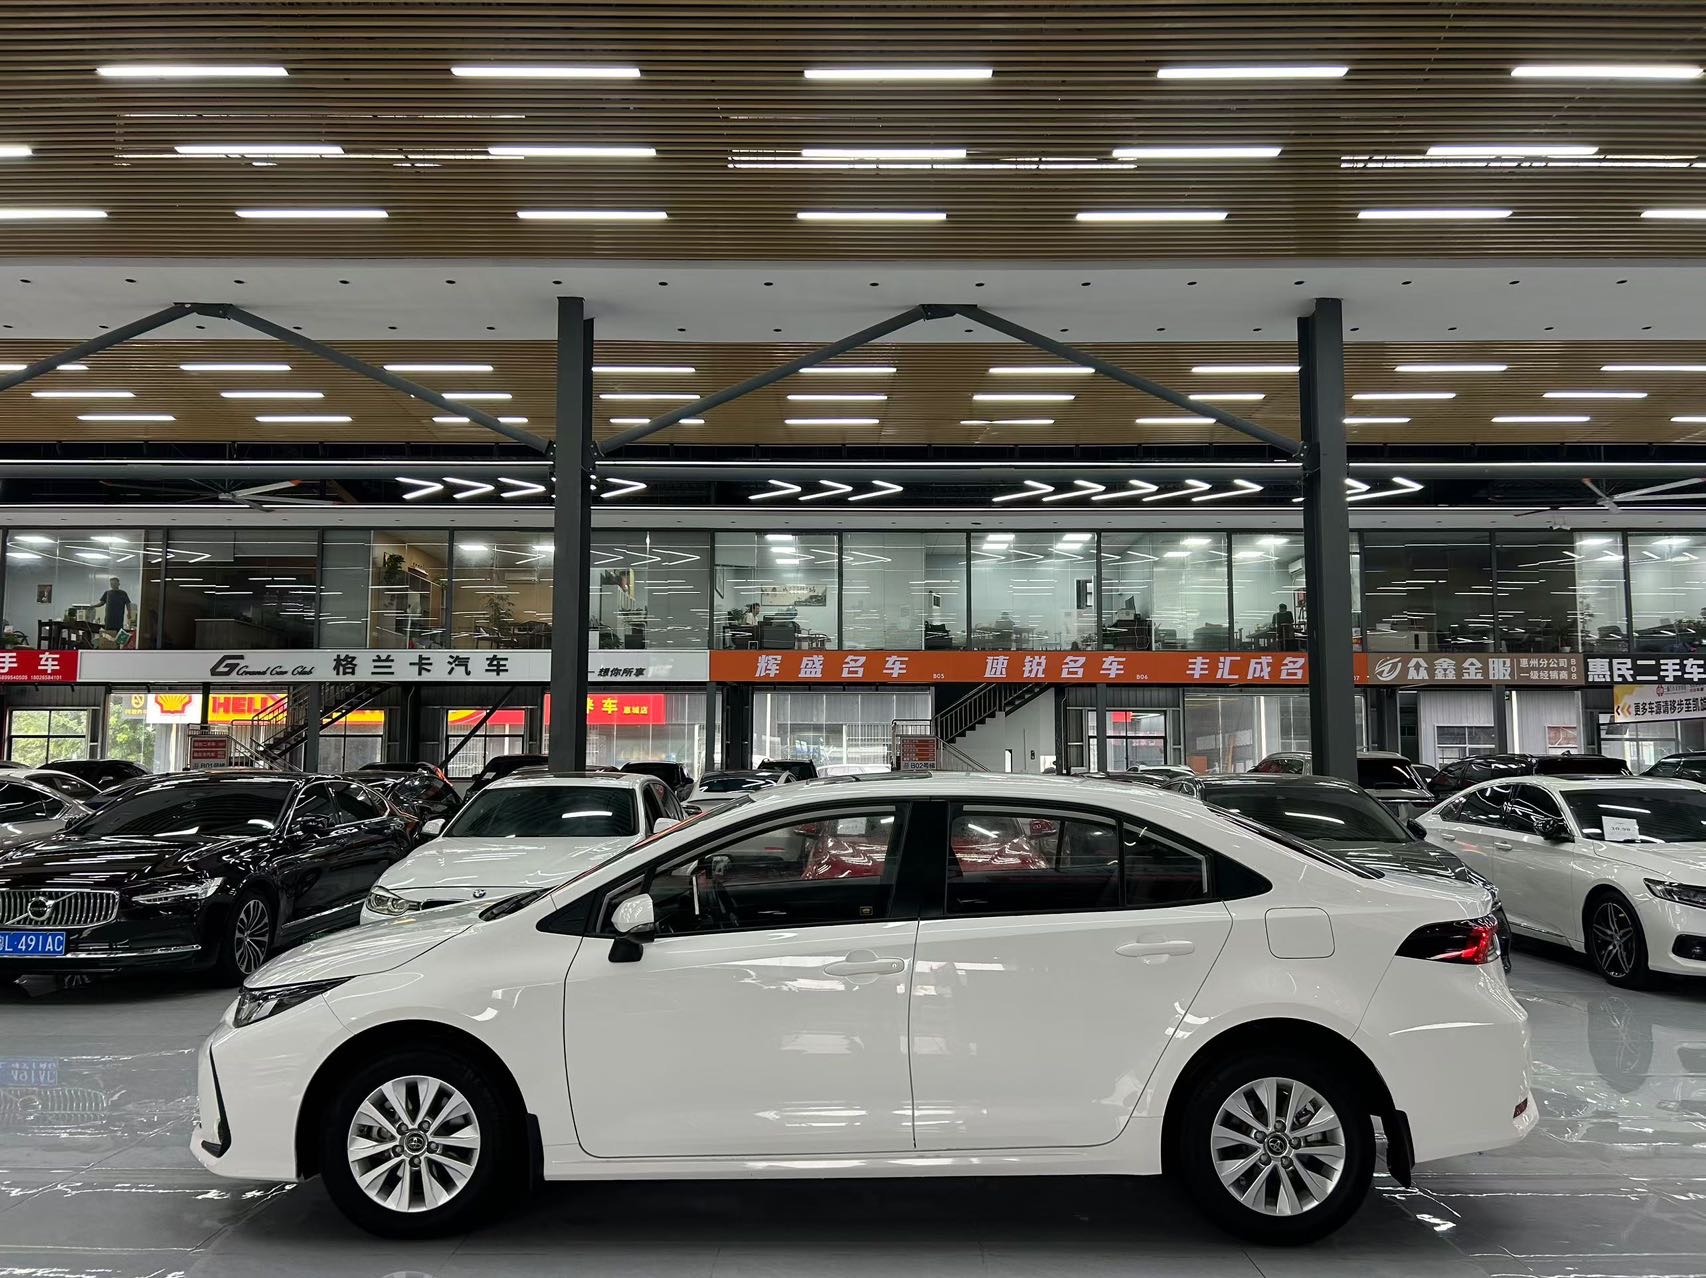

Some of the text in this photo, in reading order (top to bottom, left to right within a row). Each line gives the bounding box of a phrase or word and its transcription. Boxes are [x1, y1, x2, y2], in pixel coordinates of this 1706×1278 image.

[333, 654, 509, 676] 格兰卡汽车
[755, 655, 908, 678] 辉盛名车
[984, 655, 1126, 678] 速锐名车
[1186, 656, 1305, 680] 丰汇成名
[1408, 658, 1511, 680] 众鑫金服
[1520, 658, 1568, 668] 惠州分公司
[1587, 658, 1706, 681] 惠民二手车
[1520, 670, 1568, 680] 一级经销商
